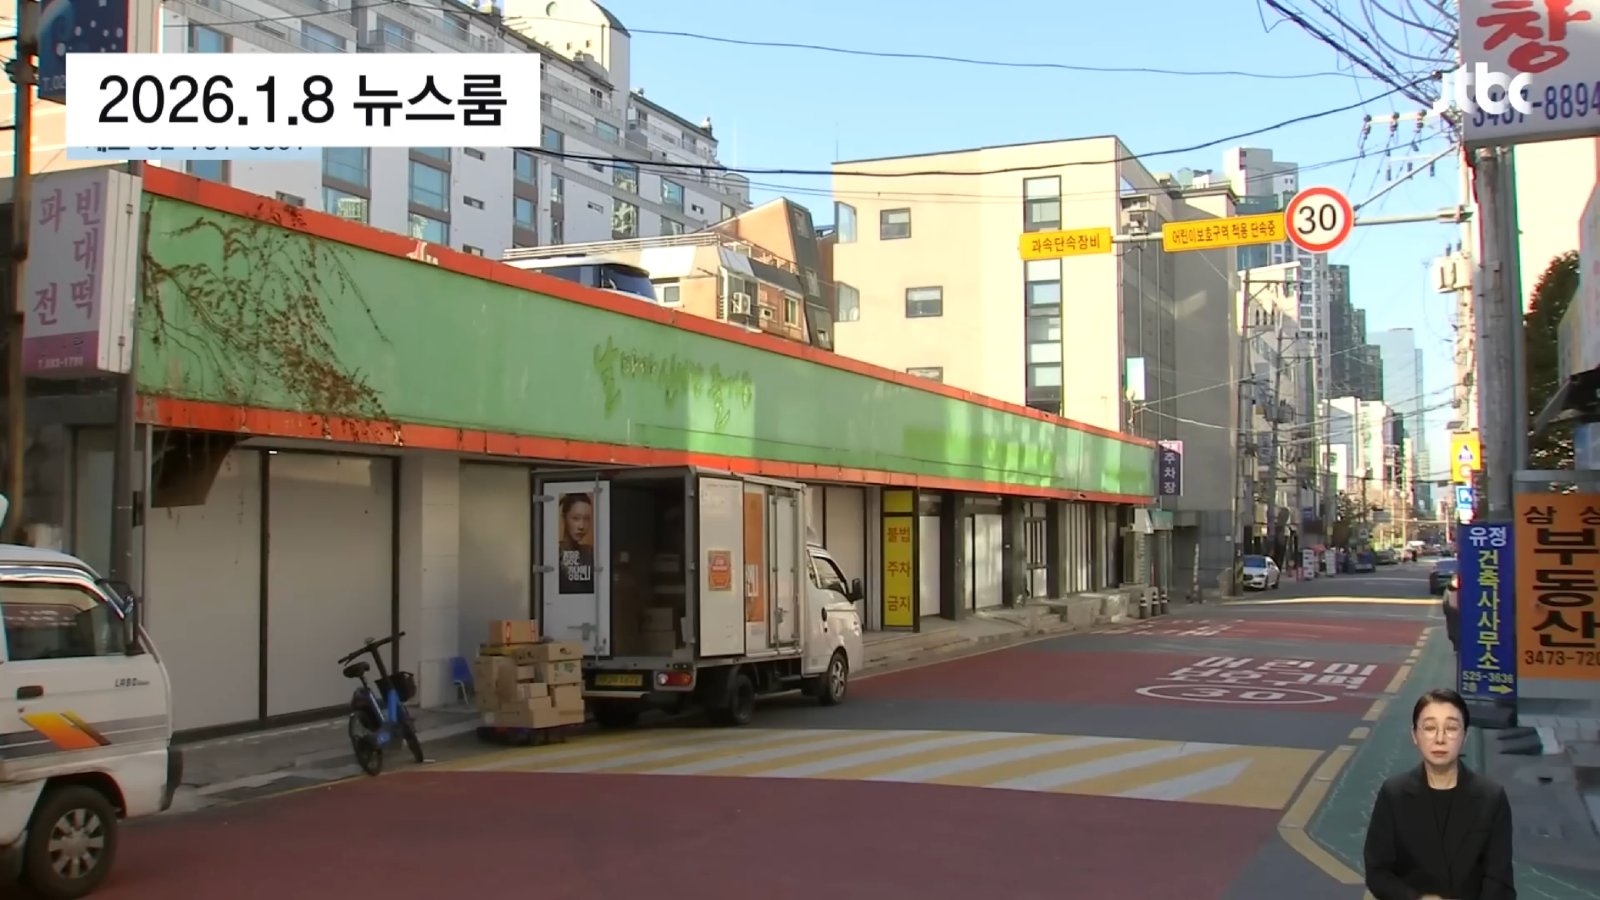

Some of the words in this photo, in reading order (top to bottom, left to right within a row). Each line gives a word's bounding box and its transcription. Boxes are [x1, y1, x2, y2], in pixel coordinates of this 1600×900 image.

[1297, 203, 1337, 235] 30
[1172, 225, 1230, 245] 어린이보호구역
[1231, 222, 1248, 239] 적용
[1250, 220, 1276, 238] 단속중
[69, 181, 101, 320] 빈대떡
[1031, 235, 1101, 254] 과속단속장비
[1163, 452, 1177, 495] 주차장
[886, 526, 911, 543] 불법
[1468, 526, 1507, 547] 유정
[886, 561, 911, 578] 주차
[1532, 528, 1600, 648] 부동산
[886, 595, 911, 613] 금지
[1477, 549, 1501, 671] 건축사사무소
[1181, 687, 1287, 701] 30
